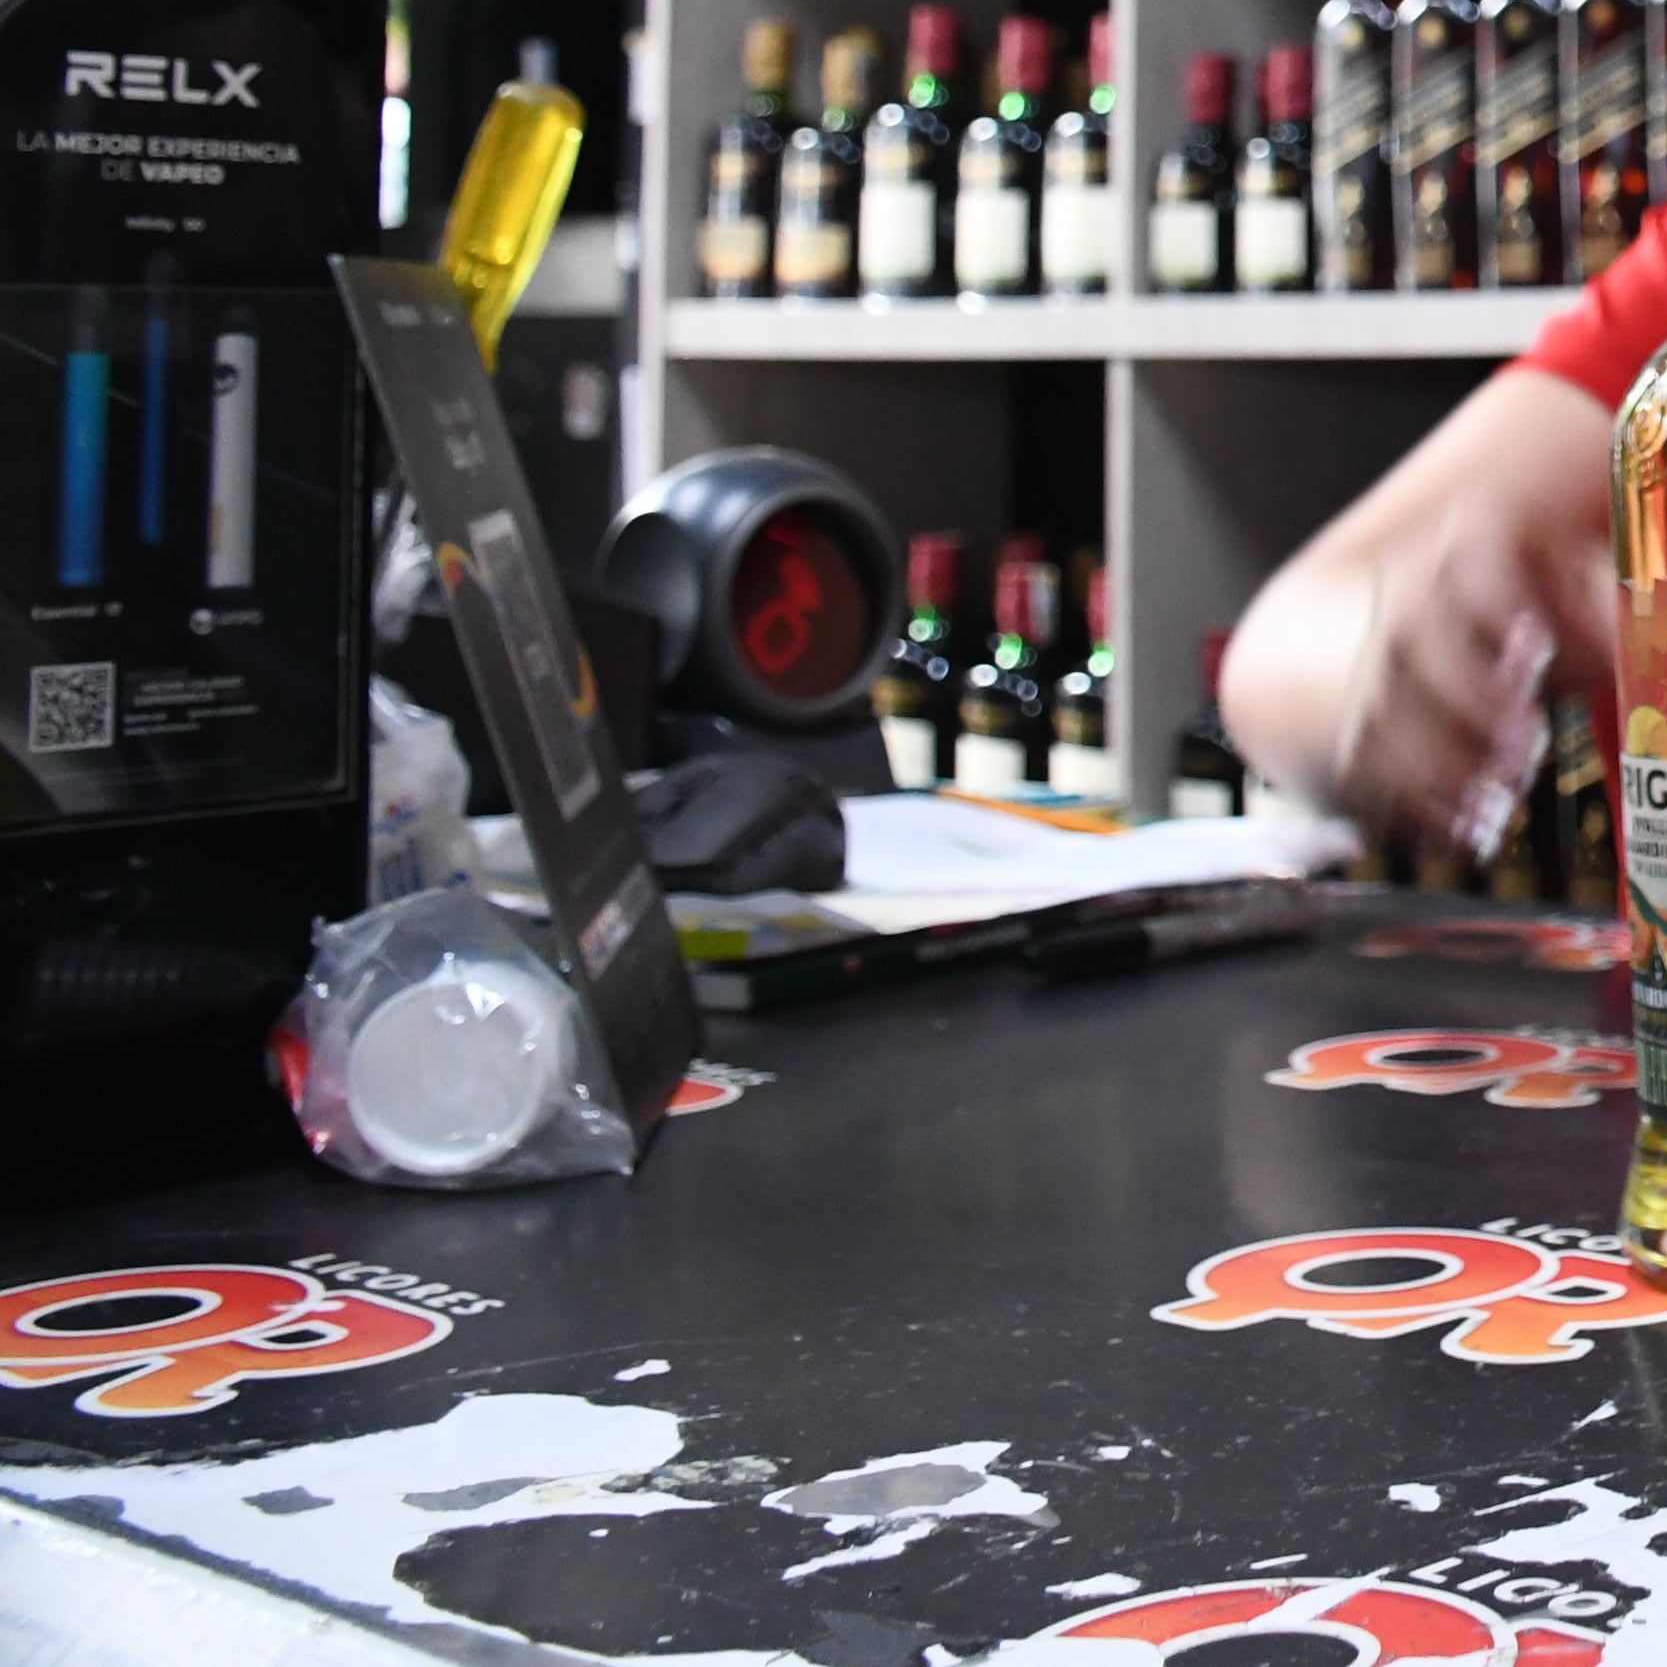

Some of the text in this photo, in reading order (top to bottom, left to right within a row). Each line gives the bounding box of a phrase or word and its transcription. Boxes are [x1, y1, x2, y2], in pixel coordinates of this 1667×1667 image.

[65, 49, 262, 108] RELX
[54, 132, 144, 156] MEJOR
[146, 135, 302, 164] EXPERIENCIA
[139, 162, 226, 186] VAPEO
[286, 1252, 506, 1316] LICORES
